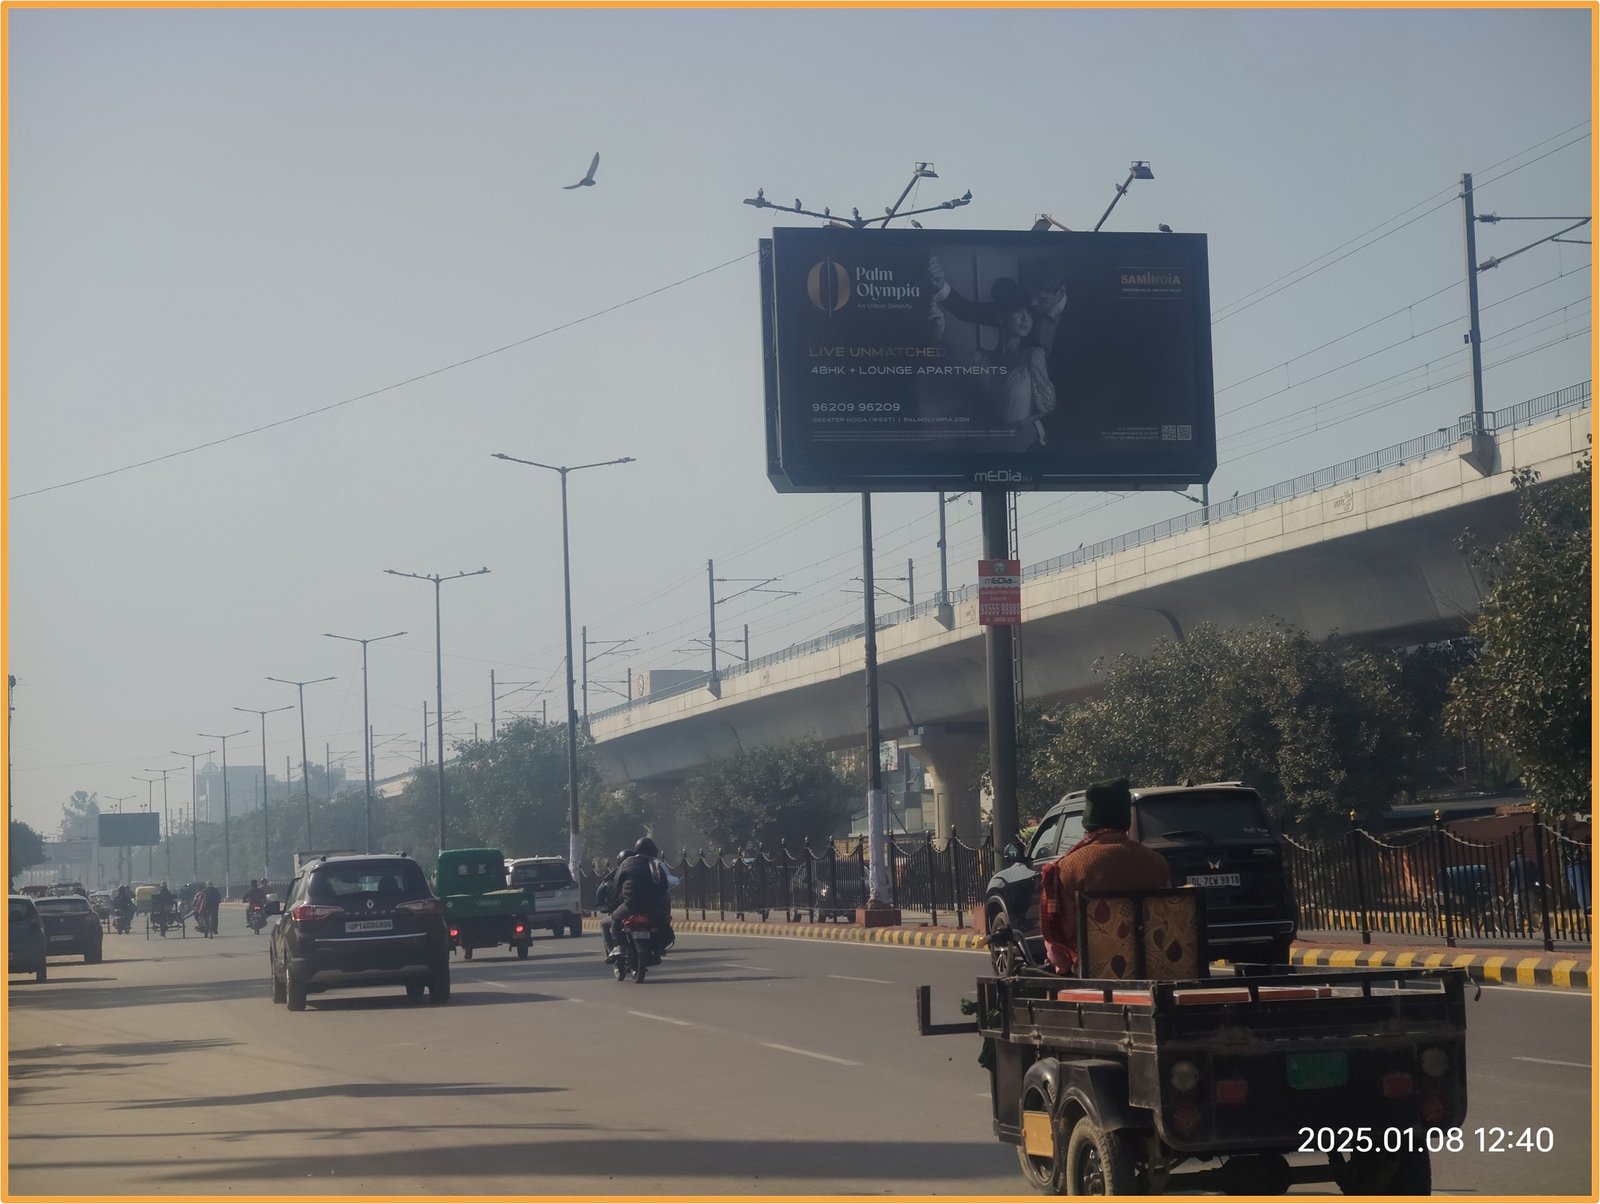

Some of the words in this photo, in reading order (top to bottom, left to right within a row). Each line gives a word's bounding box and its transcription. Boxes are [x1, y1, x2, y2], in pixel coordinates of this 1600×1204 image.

[856, 266, 893, 281] Palm
[856, 282, 920, 301] Olympia
[808, 346, 845, 357] LIVE
[849, 346, 947, 358] UNMATCHED
[810, 366, 846, 375] 4BHK
[859, 366, 913, 375] LOUNGE
[916, 366, 1008, 375] APARTMENTS
[811, 402, 855, 412] 96209
[858, 402, 901, 412] 96209
